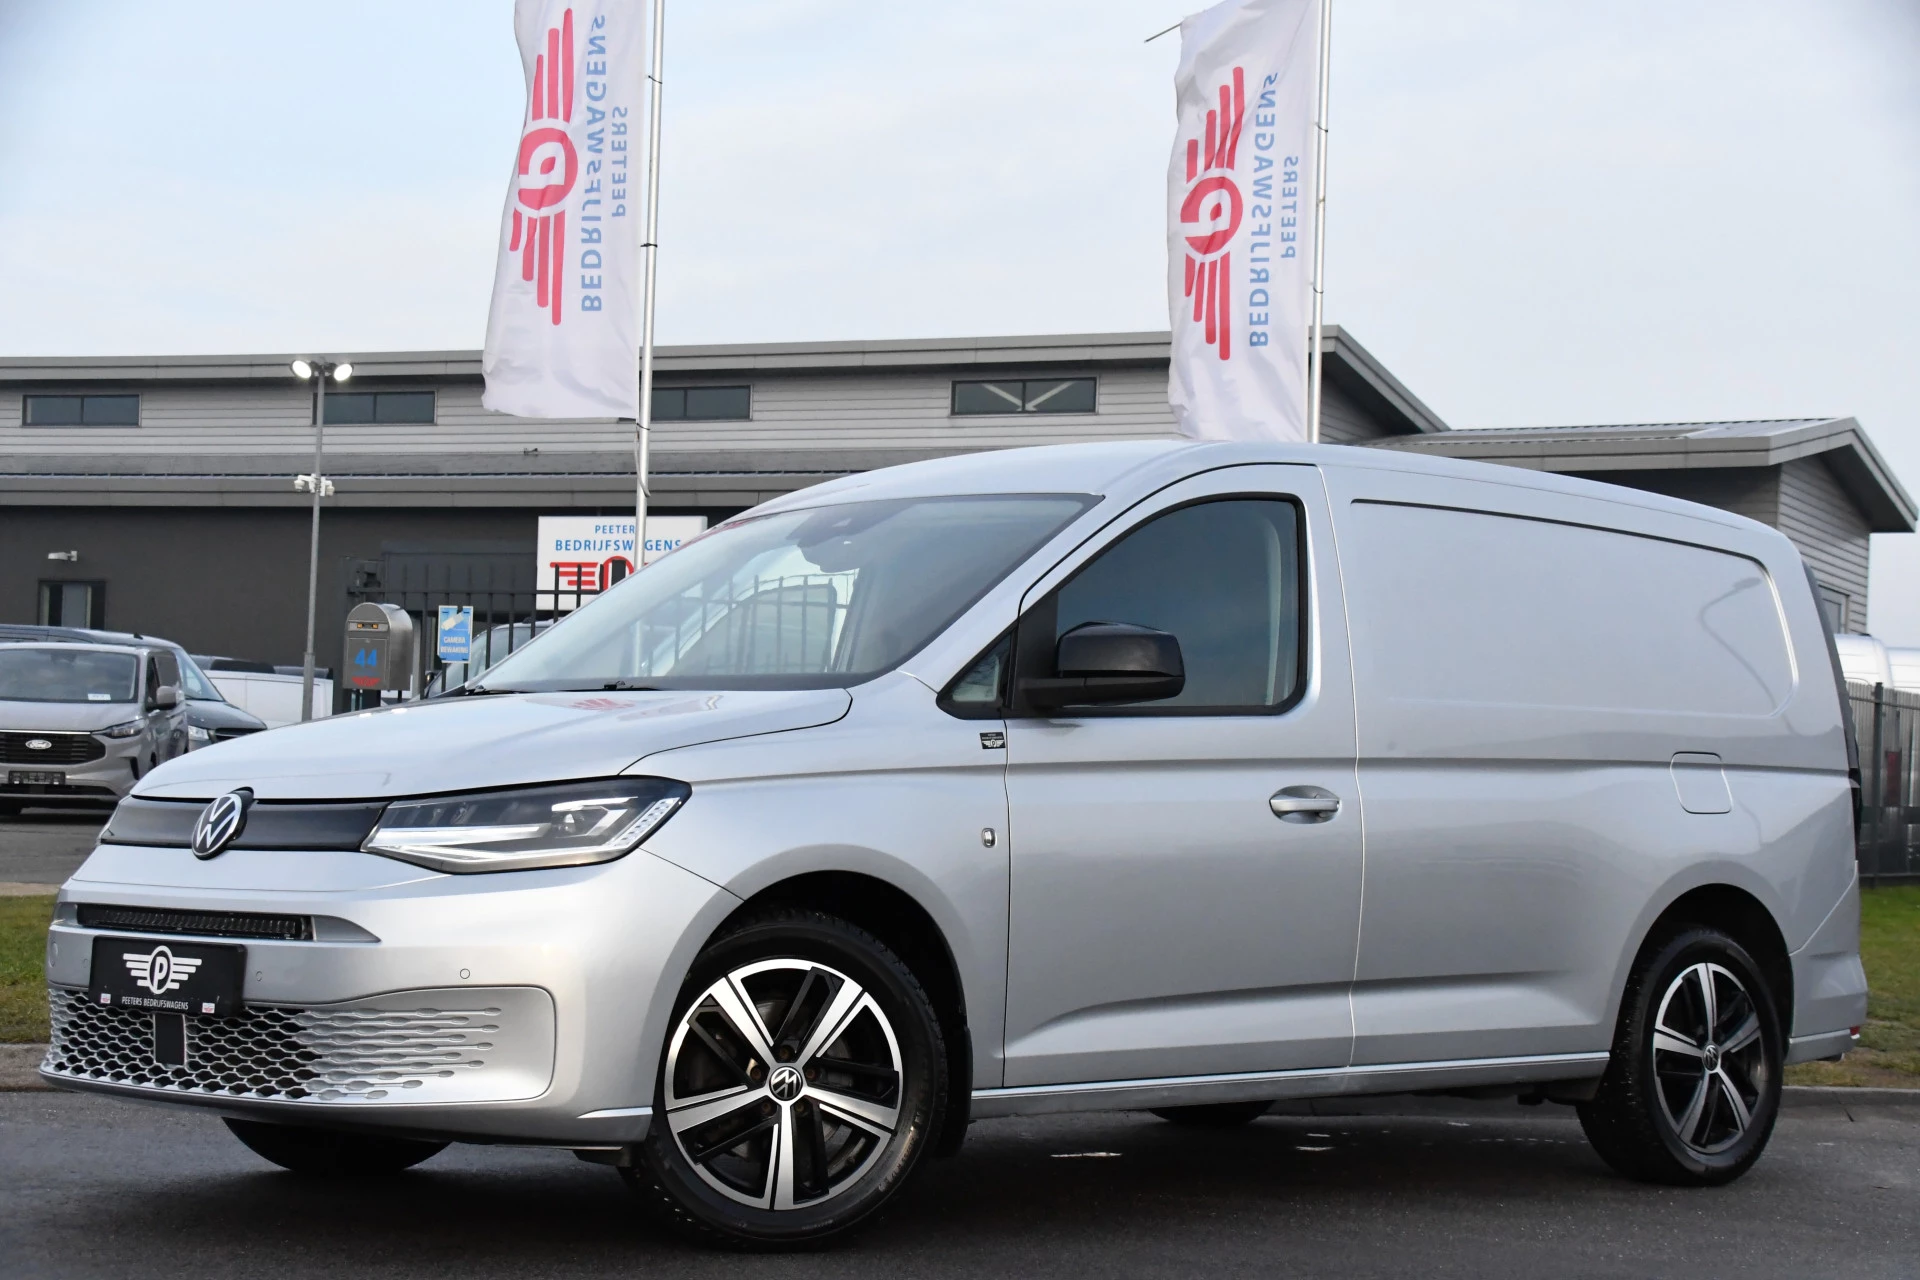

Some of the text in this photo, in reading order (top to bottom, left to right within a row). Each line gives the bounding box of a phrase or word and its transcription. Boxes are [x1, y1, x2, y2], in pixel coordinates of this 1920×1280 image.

[355, 648, 377, 667] 44
[121, 996, 189, 1010] PEETERS BEDRIJFSWAGENS
